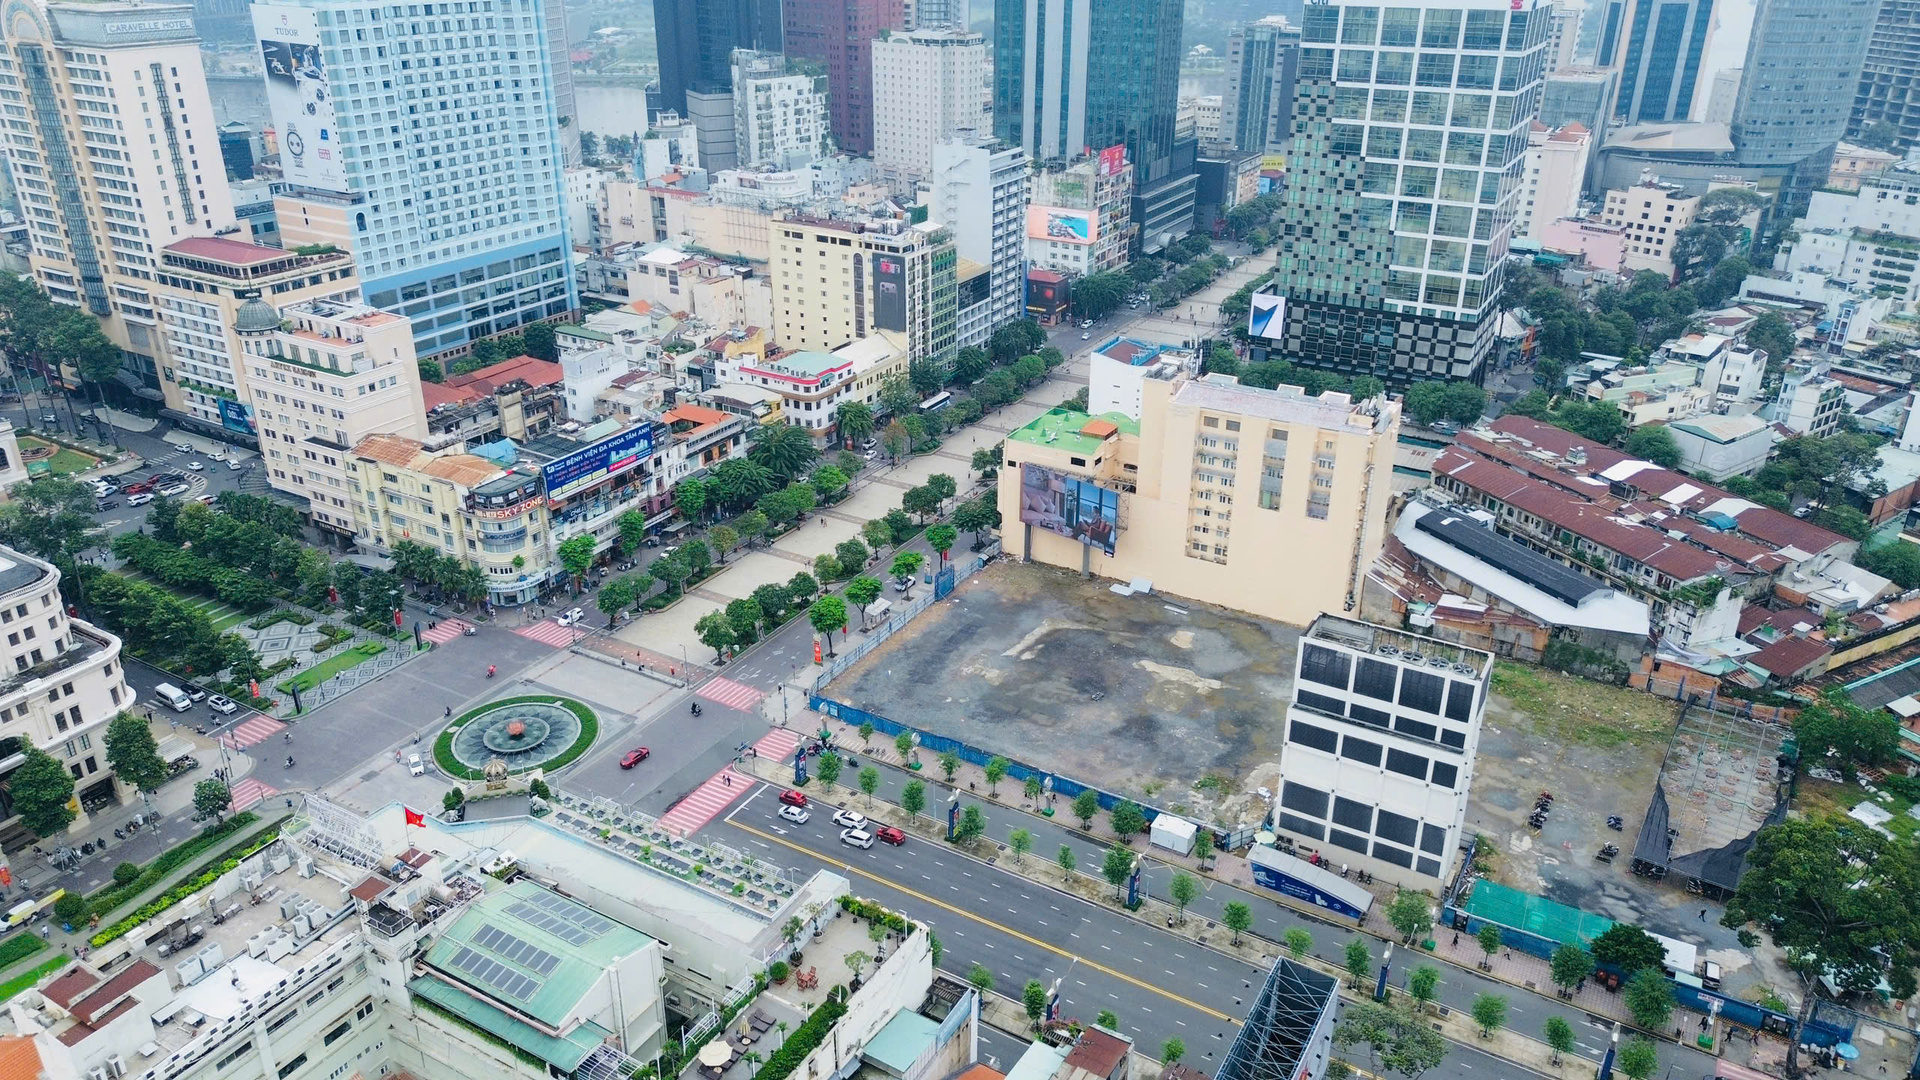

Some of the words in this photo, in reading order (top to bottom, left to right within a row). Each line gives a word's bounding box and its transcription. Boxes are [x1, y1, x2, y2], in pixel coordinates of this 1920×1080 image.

[109, 21, 160, 33] CARAVELLE
[163, 20, 191, 29] HOTEL
[274, 27, 299, 37] TUDOR
[546, 465, 555, 474] ta
[566, 455, 583, 467] BỆNH
[584, 447, 598, 460] VIỆN
[599, 444, 608, 453] ĐA
[608, 437, 625, 449] KHOA
[625, 432, 637, 441] TÂM
[638, 426, 650, 436] ANH
[497, 506, 519, 519] SKY
[519, 496, 543, 512] ZONE
[491, 583, 525, 592] Information
[525, 577, 542, 586] Center
